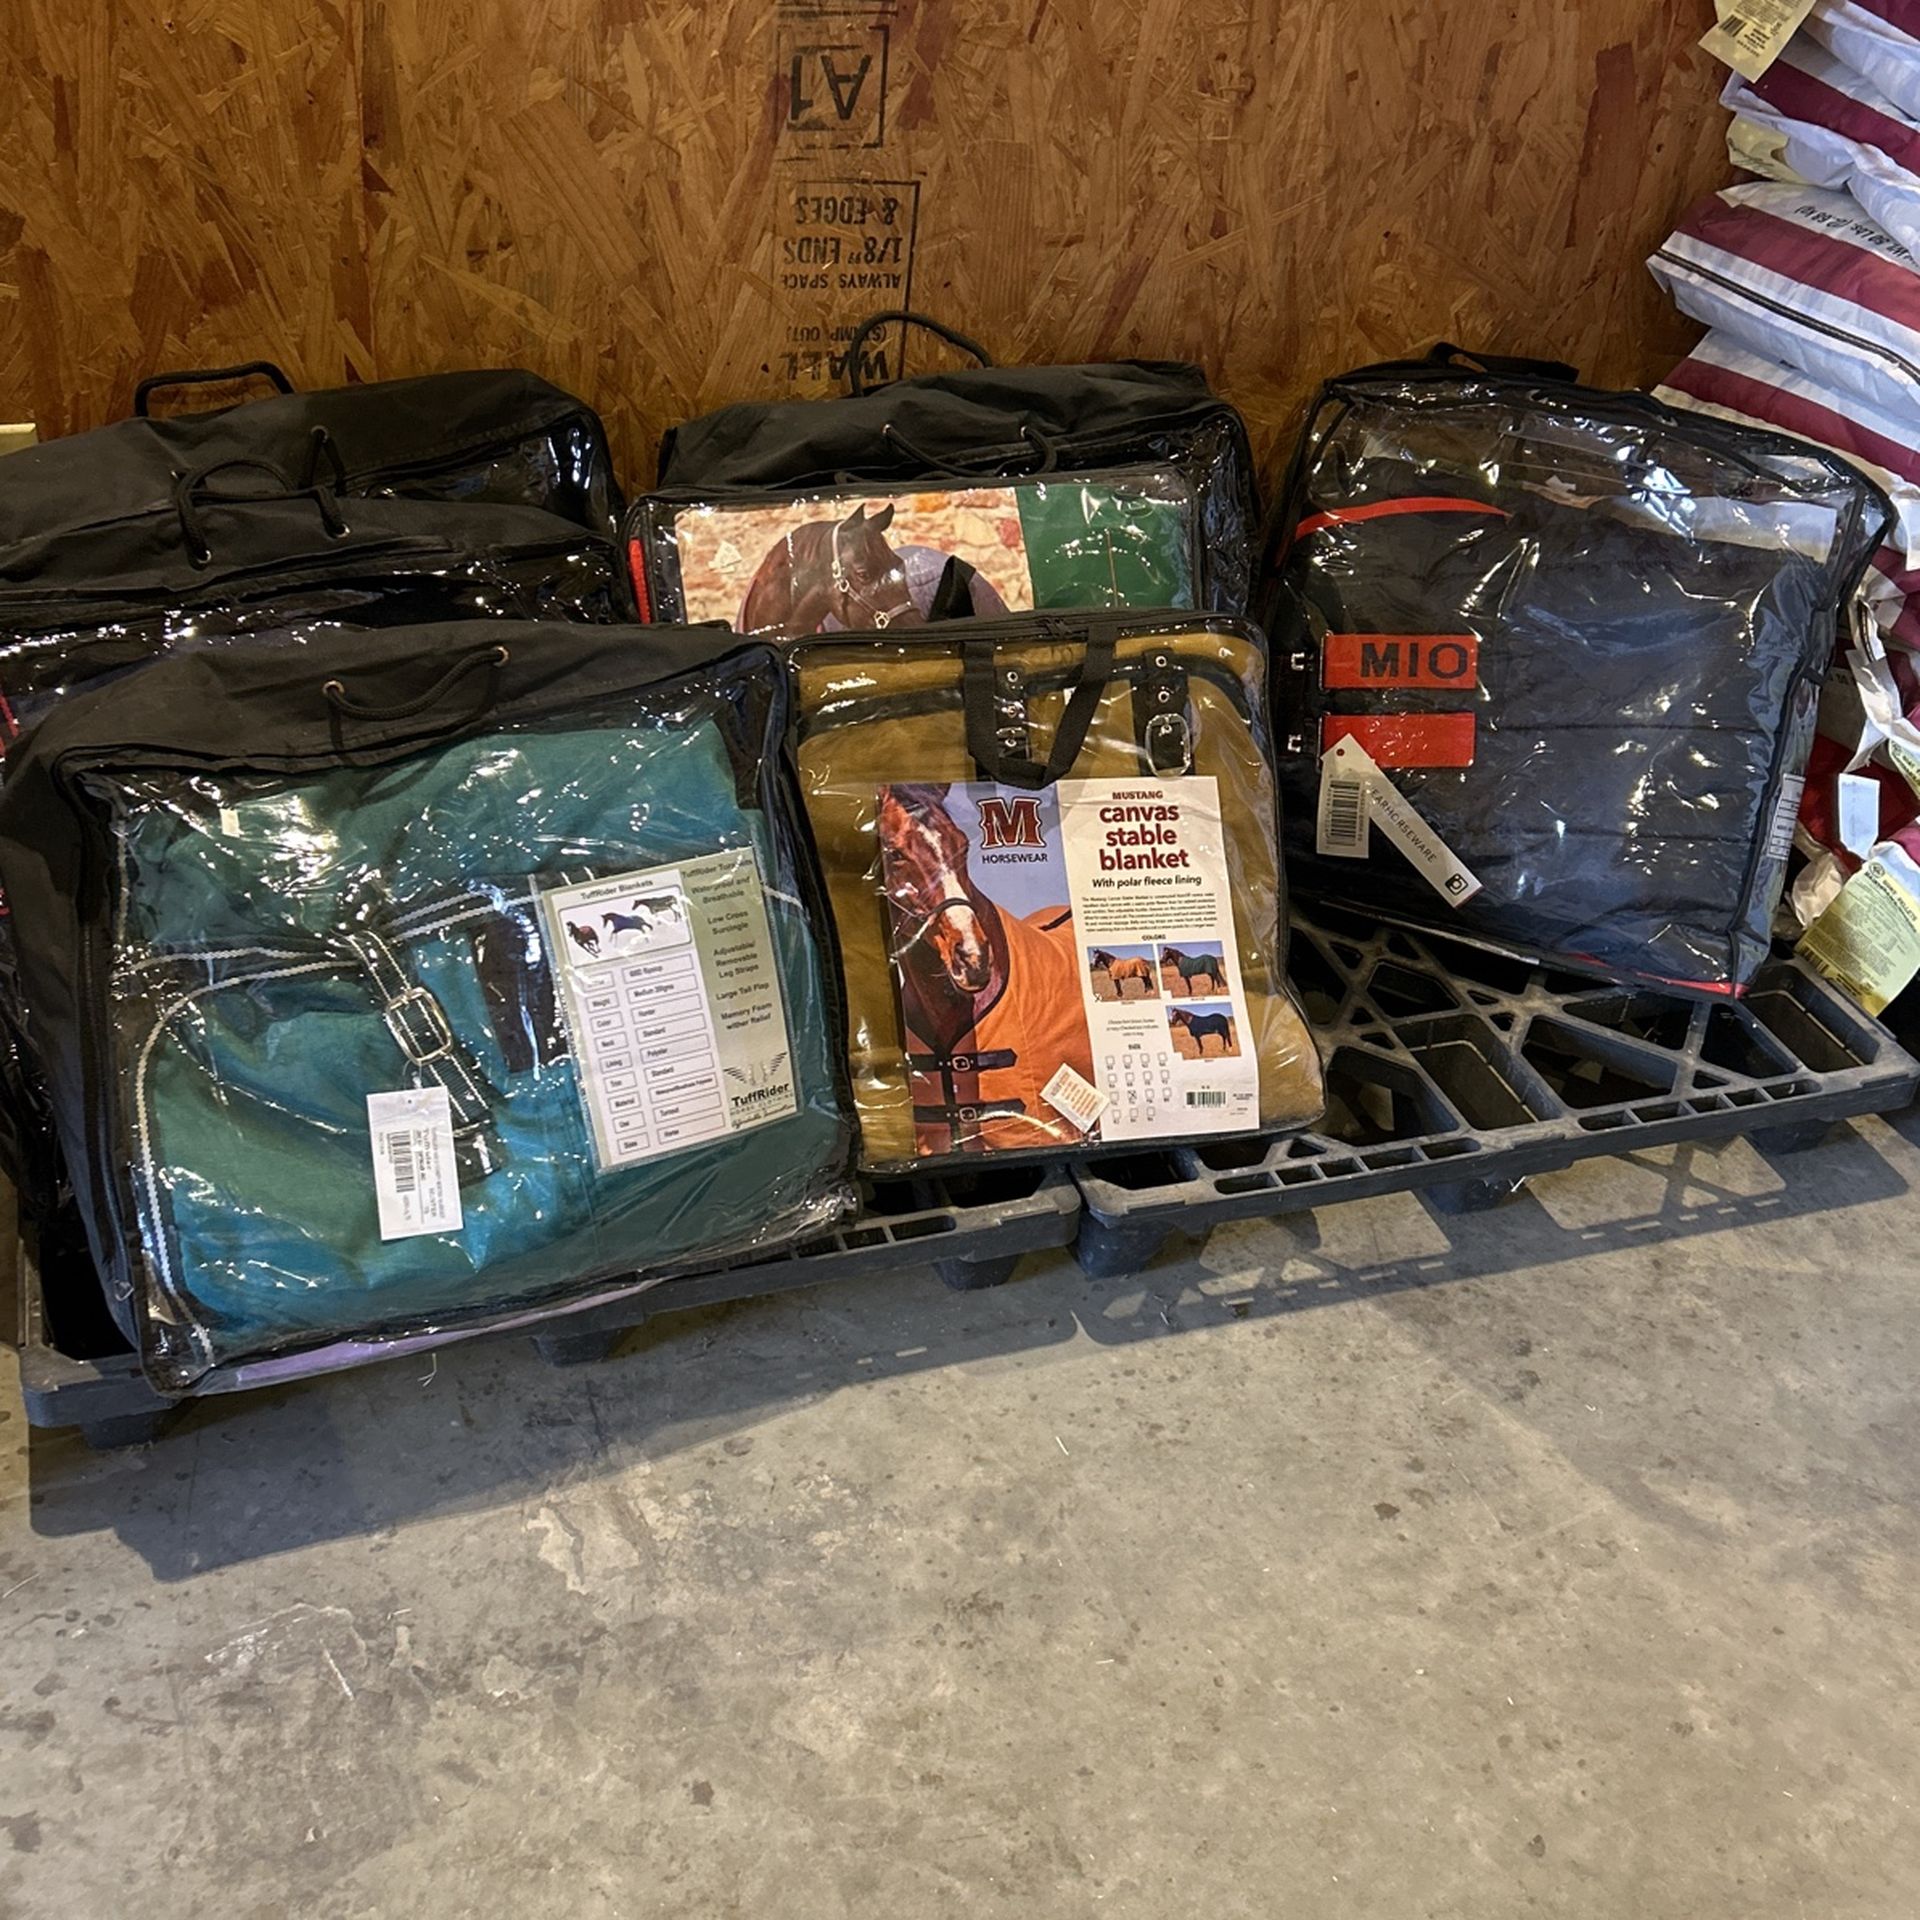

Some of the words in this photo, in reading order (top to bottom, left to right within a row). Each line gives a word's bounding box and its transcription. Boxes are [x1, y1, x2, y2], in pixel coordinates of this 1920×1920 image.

[788, 54, 873, 121] A1
[796, 196, 869, 225] EDGES
[783, 236, 841, 265] ENDS
[839, 273, 901, 289] ALWAYS
[779, 350, 889, 380] WALL
[1360, 642, 1467, 679] MIO
[1112, 790, 1163, 801] MUSTANG
[1099, 803, 1179, 824] canvas
[1106, 824, 1177, 847] stable
[981, 853, 1048, 865] HORSEWEAR
[1099, 847, 1190, 871] blanket
[618, 878, 653, 892] Blankets
[1092, 877, 1115, 889] With
[1117, 877, 1142, 891] polar
[1144, 875, 1171, 888] fleece
[1174, 874, 1202, 889] lining
[707, 915, 724, 924] Low
[725, 909, 748, 920] Cross
[712, 922, 749, 935] Surcingle
[715, 953, 758, 966] Removable
[719, 970, 734, 979] Leg
[735, 964, 759, 975] Straps
[715, 990, 738, 1001] Large
[753, 981, 770, 992] Flap
[721, 1008, 750, 1021] Memory
[752, 1002, 772, 1012] Foam
[750, 1013, 771, 1024] Relief
[731, 1082, 791, 1107] TuffRider
